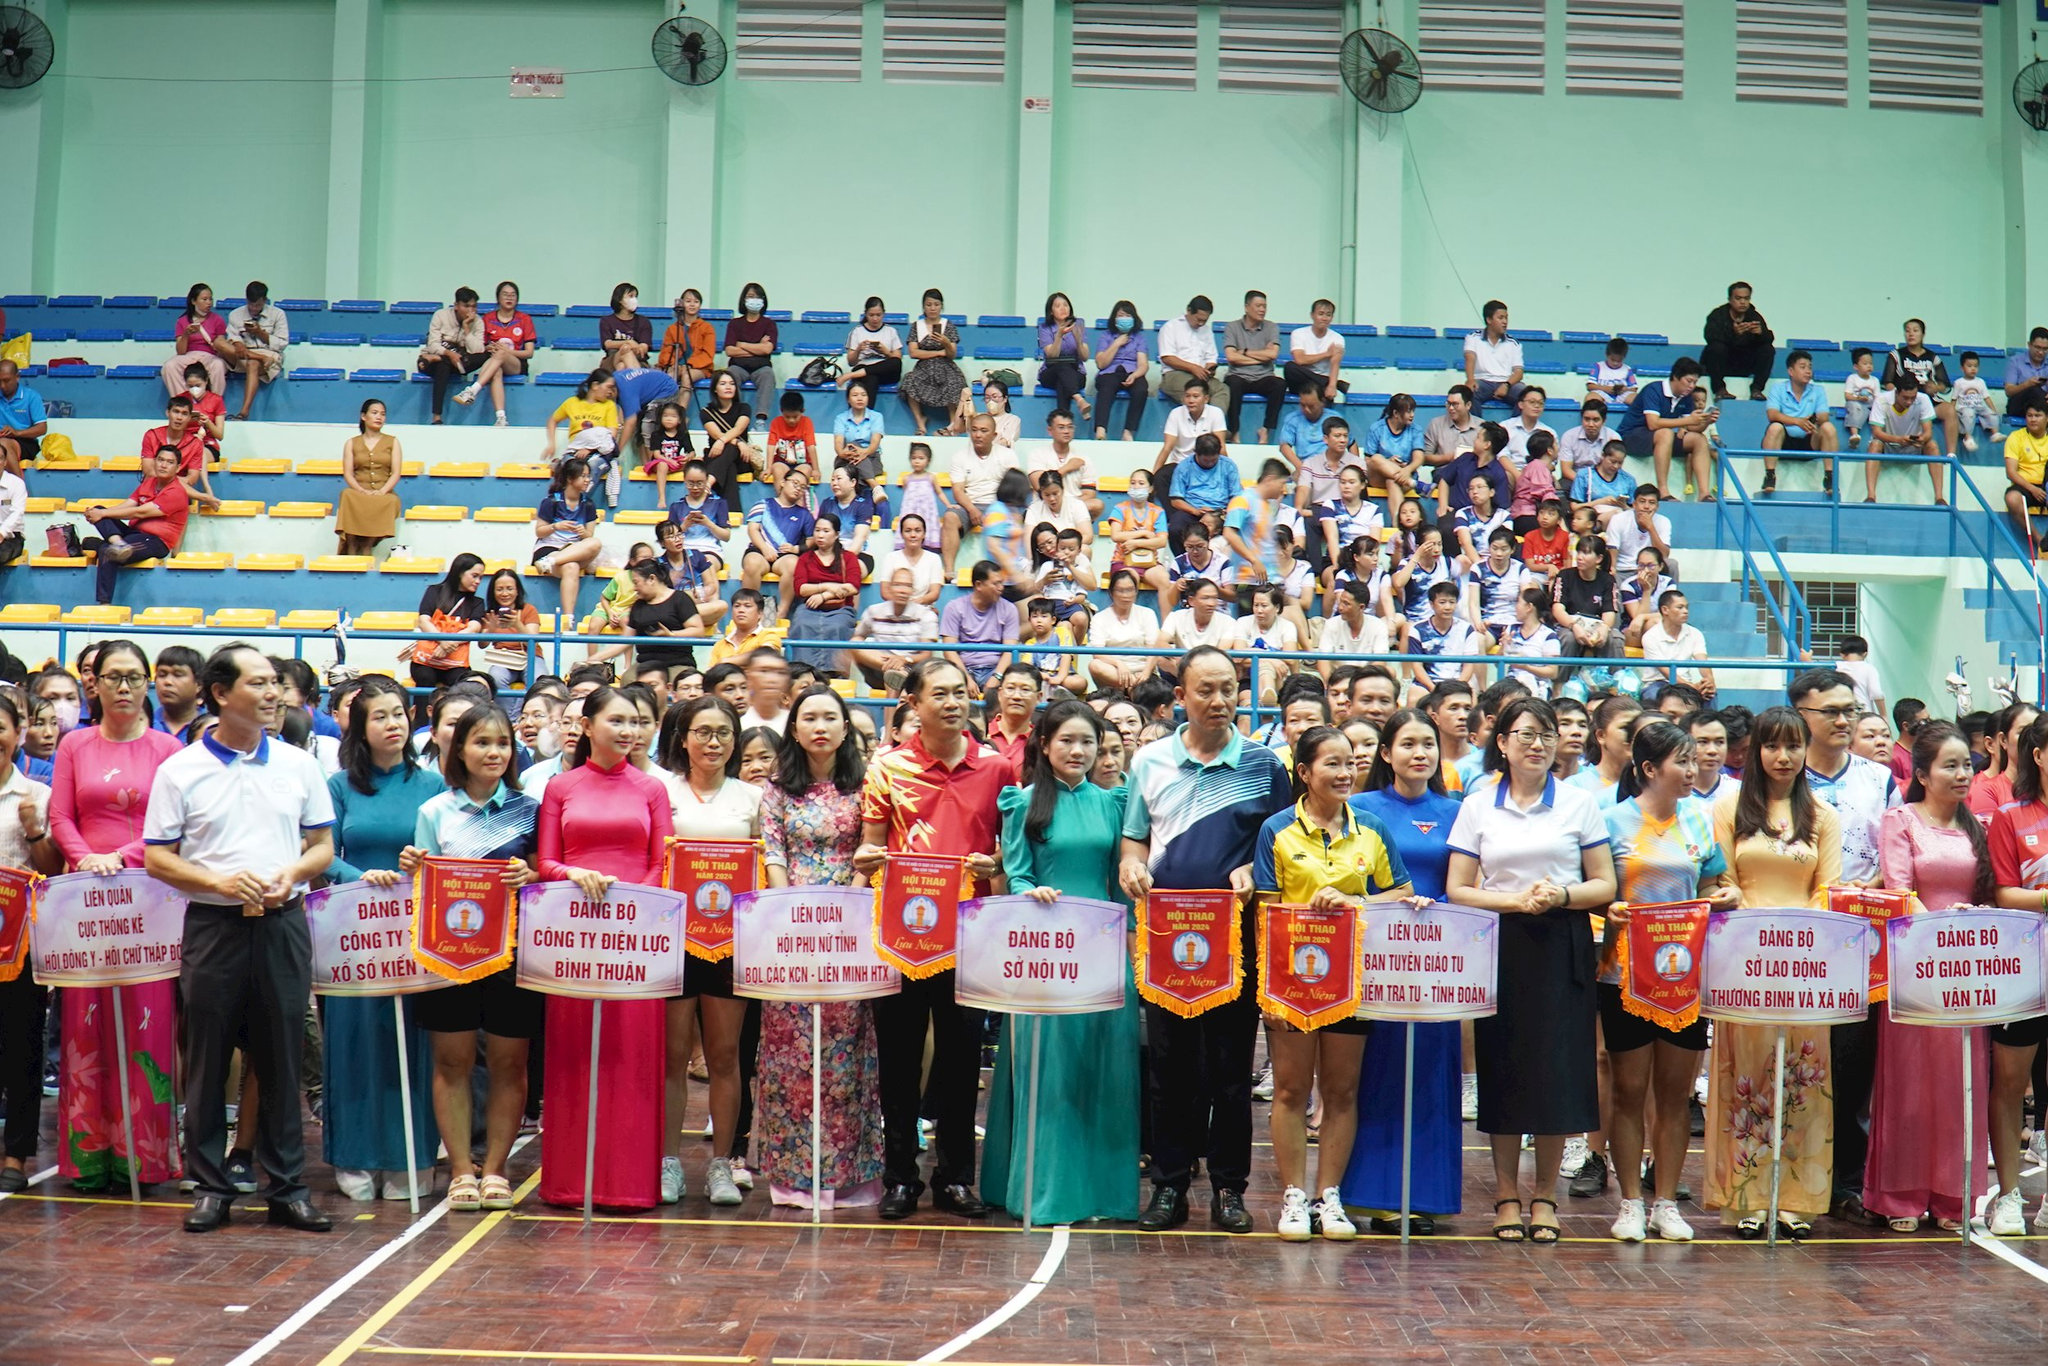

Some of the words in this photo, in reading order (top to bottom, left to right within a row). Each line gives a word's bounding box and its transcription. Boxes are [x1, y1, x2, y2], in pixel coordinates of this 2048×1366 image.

[691, 860, 709, 870] HỘI
[712, 861, 738, 870] THAO
[696, 870, 713, 879] NĂM
[442, 879, 461, 890] HỘI
[464, 881, 492, 890] THAO
[902, 874, 918, 886] HỘI
[921, 876, 946, 886] THAO
[906, 886, 922, 894] NĂM
[84, 889, 105, 908] LIÊN
[107, 888, 132, 907] QUÂN
[358, 896, 400, 920] ĐẢNG
[404, 899, 414, 916] B
[570, 896, 610, 920] ĐẢNG
[616, 900, 636, 925] BỘ
[792, 904, 812, 924] LIÊN
[816, 903, 842, 924] QUÂN
[1167, 910, 1185, 922] HỘI
[1188, 912, 1216, 921] THAO
[1866, 906, 1891, 917] THAO
[78, 917, 97, 943] CỤC
[99, 912, 130, 937] THỐNG
[132, 914, 144, 934] KÊ
[1172, 922, 1190, 930] NĂM
[1309, 924, 1336, 934] THAO
[1388, 920, 1411, 942] LIÊN
[1414, 922, 1442, 943] QUÂN
[1647, 922, 1665, 934] HỘI
[1668, 922, 1694, 932] THAO
[1937, 925, 1975, 948] ĐẢNG
[1980, 925, 1998, 950] BỘ
[340, 930, 382, 952] CÔNG
[386, 930, 404, 947] TY
[534, 926, 574, 948] CÔNG
[580, 932, 596, 950] TY
[601, 930, 638, 955] ĐIỆN
[642, 934, 670, 957] LỰC
[777, 933, 793, 958] HỘI
[796, 936, 816, 958] PHỤ
[818, 933, 834, 953] NỮ
[835, 930, 857, 953] TỈNH
[1008, 925, 1050, 949] ĐẢNG
[1055, 928, 1075, 953] BỘ
[1653, 934, 1670, 942] NĂM
[1758, 924, 1794, 948] ĐẢNG
[1798, 926, 1814, 952] BỘ
[45, 950, 60, 973] HỘI
[63, 947, 88, 969] ĐÔNG
[90, 951, 97, 968] Y
[105, 945, 121, 971] HỘI
[122, 944, 142, 966] CHỮ
[144, 941, 168, 968] THẬP
[170, 938, 182, 960] ĐỎ
[1364, 954, 1386, 971] BAN
[1389, 950, 1420, 972] TUYÊN
[1424, 952, 1448, 973] GIÁO
[1452, 955, 1464, 973] TU
[1916, 955, 1934, 980] SỞ
[1939, 959, 1971, 978] GIAO
[1976, 954, 2021, 976] THÔNG
[331, 958, 352, 984] XỔ
[356, 956, 376, 981] SỐ
[381, 954, 416, 978] KIẾN
[554, 957, 591, 980] BÌNH
[596, 960, 646, 986] THUẬN
[745, 967, 764, 984] BQL
[766, 962, 786, 983] CÁC
[789, 966, 808, 982] KCN
[818, 962, 840, 982] LIÊN
[842, 965, 868, 982] MINH
[871, 965, 889, 982] HTX
[1004, 955, 1024, 979] SỞ
[1028, 958, 1054, 983] NỘI
[1060, 962, 1079, 984] VỤ
[1745, 954, 1762, 978] SỞ
[1766, 960, 1788, 978] LAO
[1792, 958, 1826, 982] ĐỘNG
[1162, 974, 1186, 986] Lưu
[1190, 974, 1217, 987] Niệm
[1387, 984, 1406, 1002] TRA
[1409, 985, 1421, 1003] TU
[1432, 979, 1454, 1004] TỈNH
[1458, 982, 1486, 1004] ĐOÀN
[1712, 988, 1760, 1008] THƯƠNG
[1765, 990, 1794, 1008] BINH
[1798, 988, 1814, 1009] VÀ
[1818, 988, 1834, 1009] XÃ
[1838, 988, 1859, 1013] HỘI
[1942, 986, 1970, 1012] VẬN
[1974, 984, 1996, 1006] TẢI
